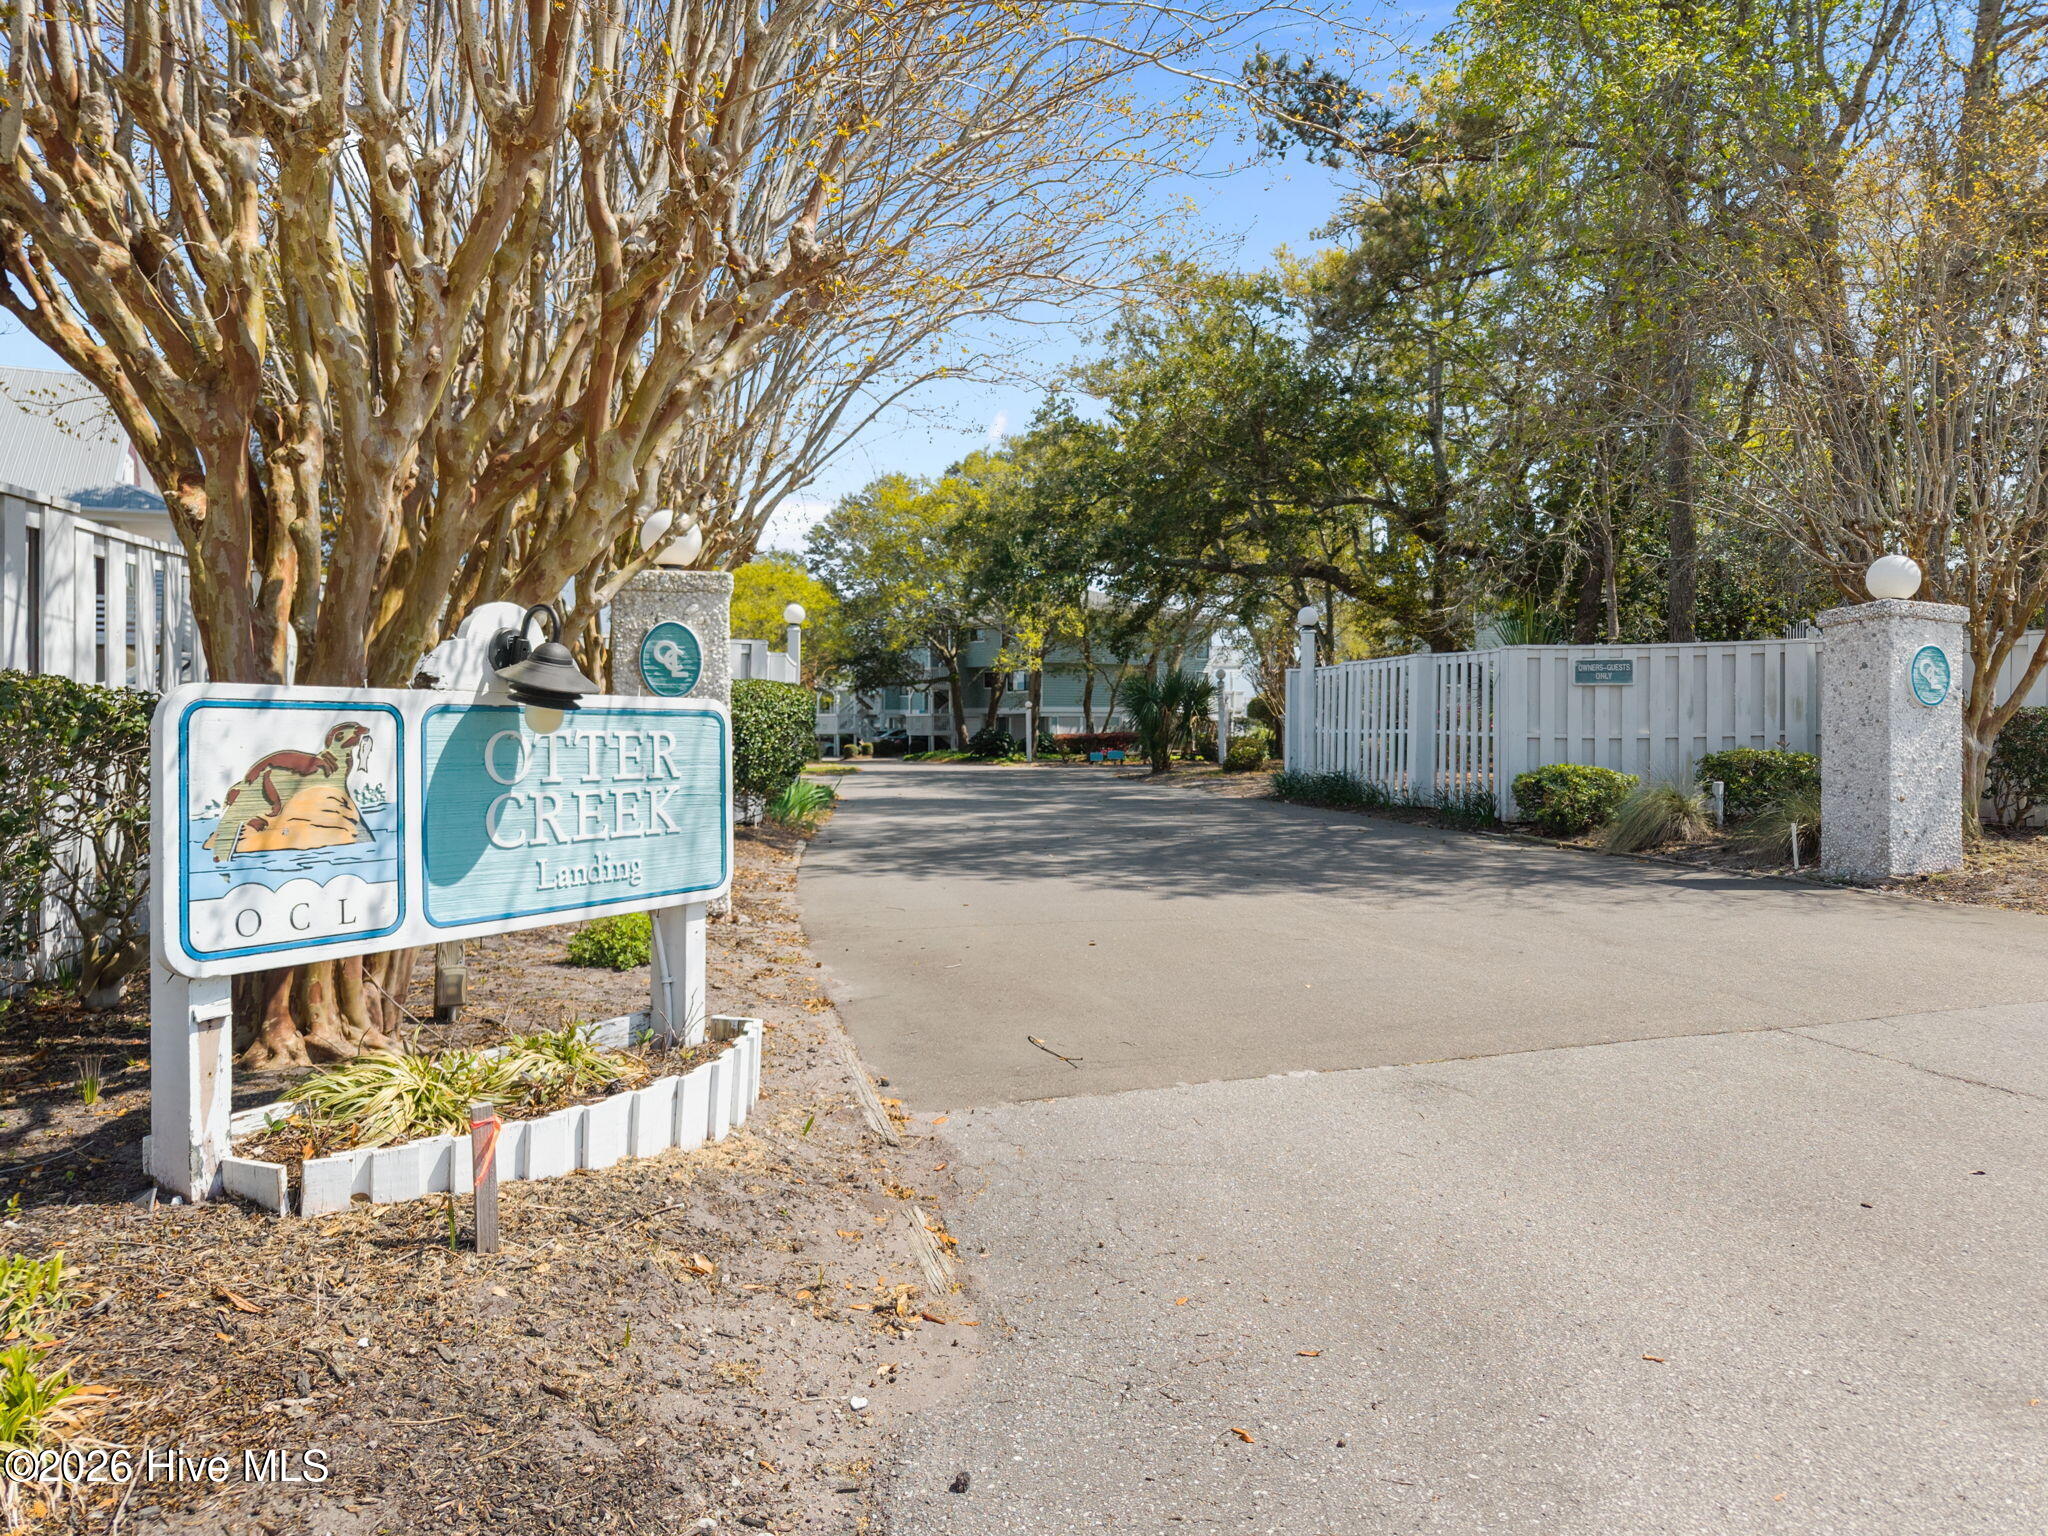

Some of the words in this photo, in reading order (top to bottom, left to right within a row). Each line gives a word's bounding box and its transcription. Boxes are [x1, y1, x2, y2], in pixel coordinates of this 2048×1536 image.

[1595, 672, 1613, 680] ONLY
[484, 728, 683, 786] OTTER
[485, 784, 682, 850] CREEK
[536, 850, 643, 891] Landing
